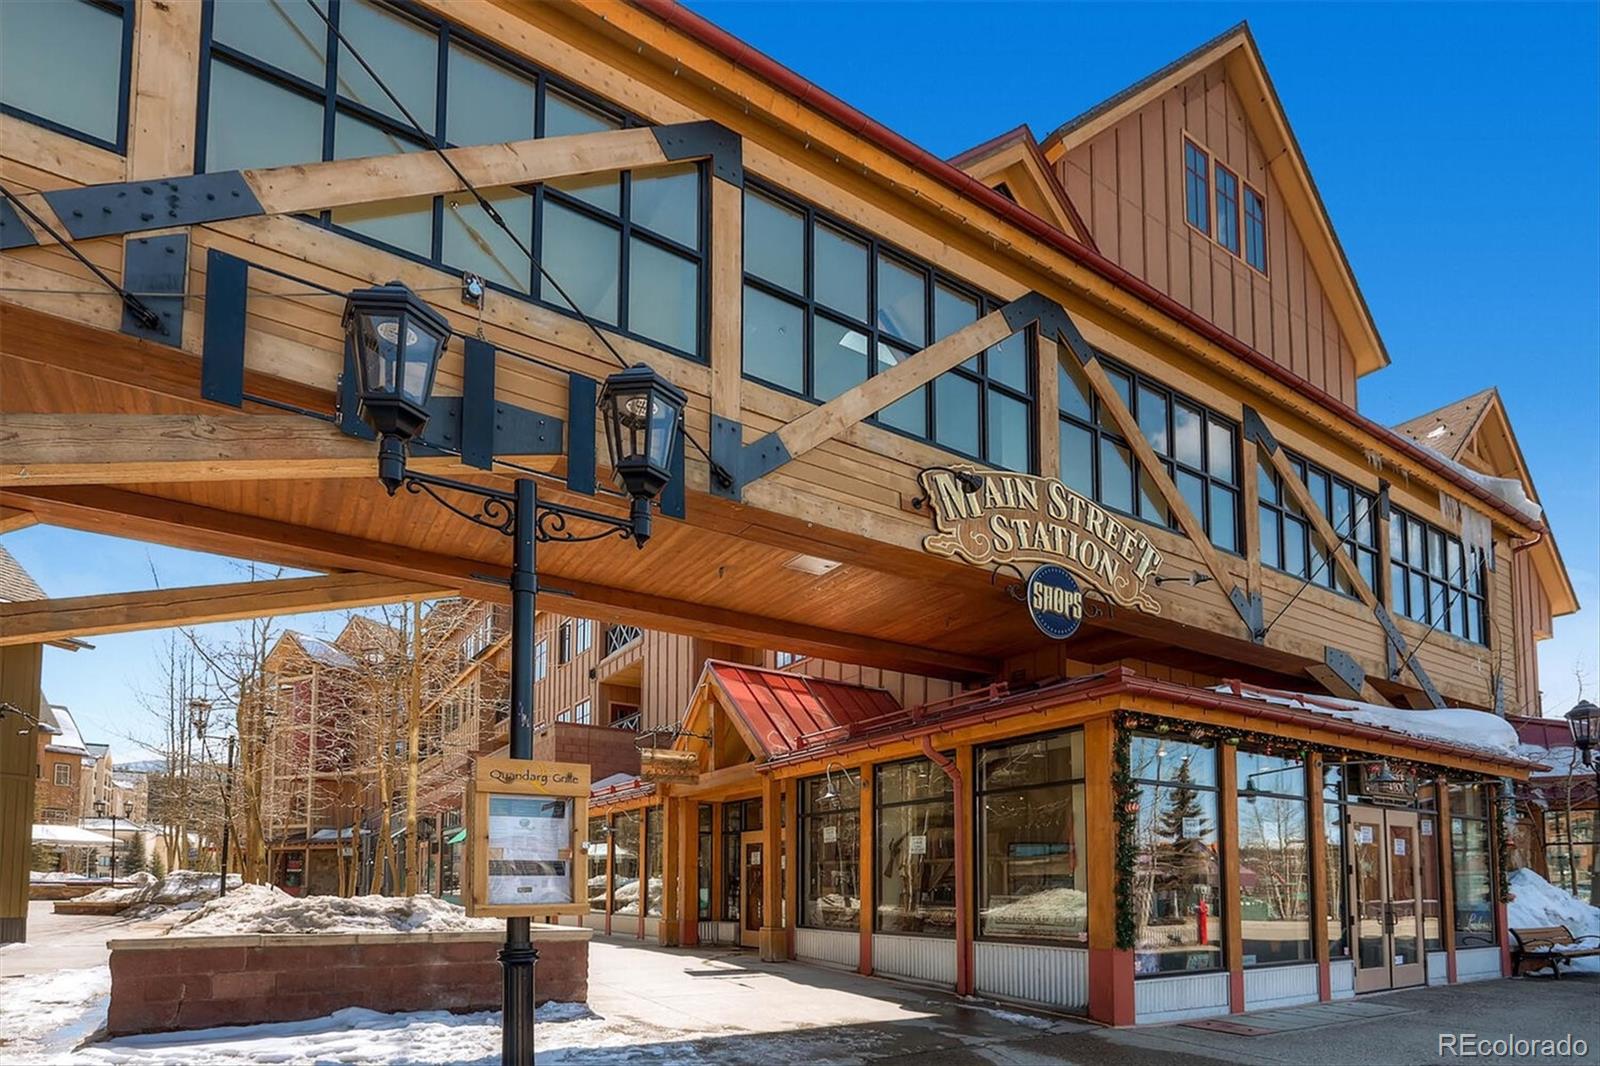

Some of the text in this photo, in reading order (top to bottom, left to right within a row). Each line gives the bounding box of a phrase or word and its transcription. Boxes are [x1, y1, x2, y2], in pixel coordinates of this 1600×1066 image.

[934, 473, 1161, 581] MAIN STREET
[990, 515, 1120, 585] STATION
[1033, 581, 1083, 621] SHOPS
